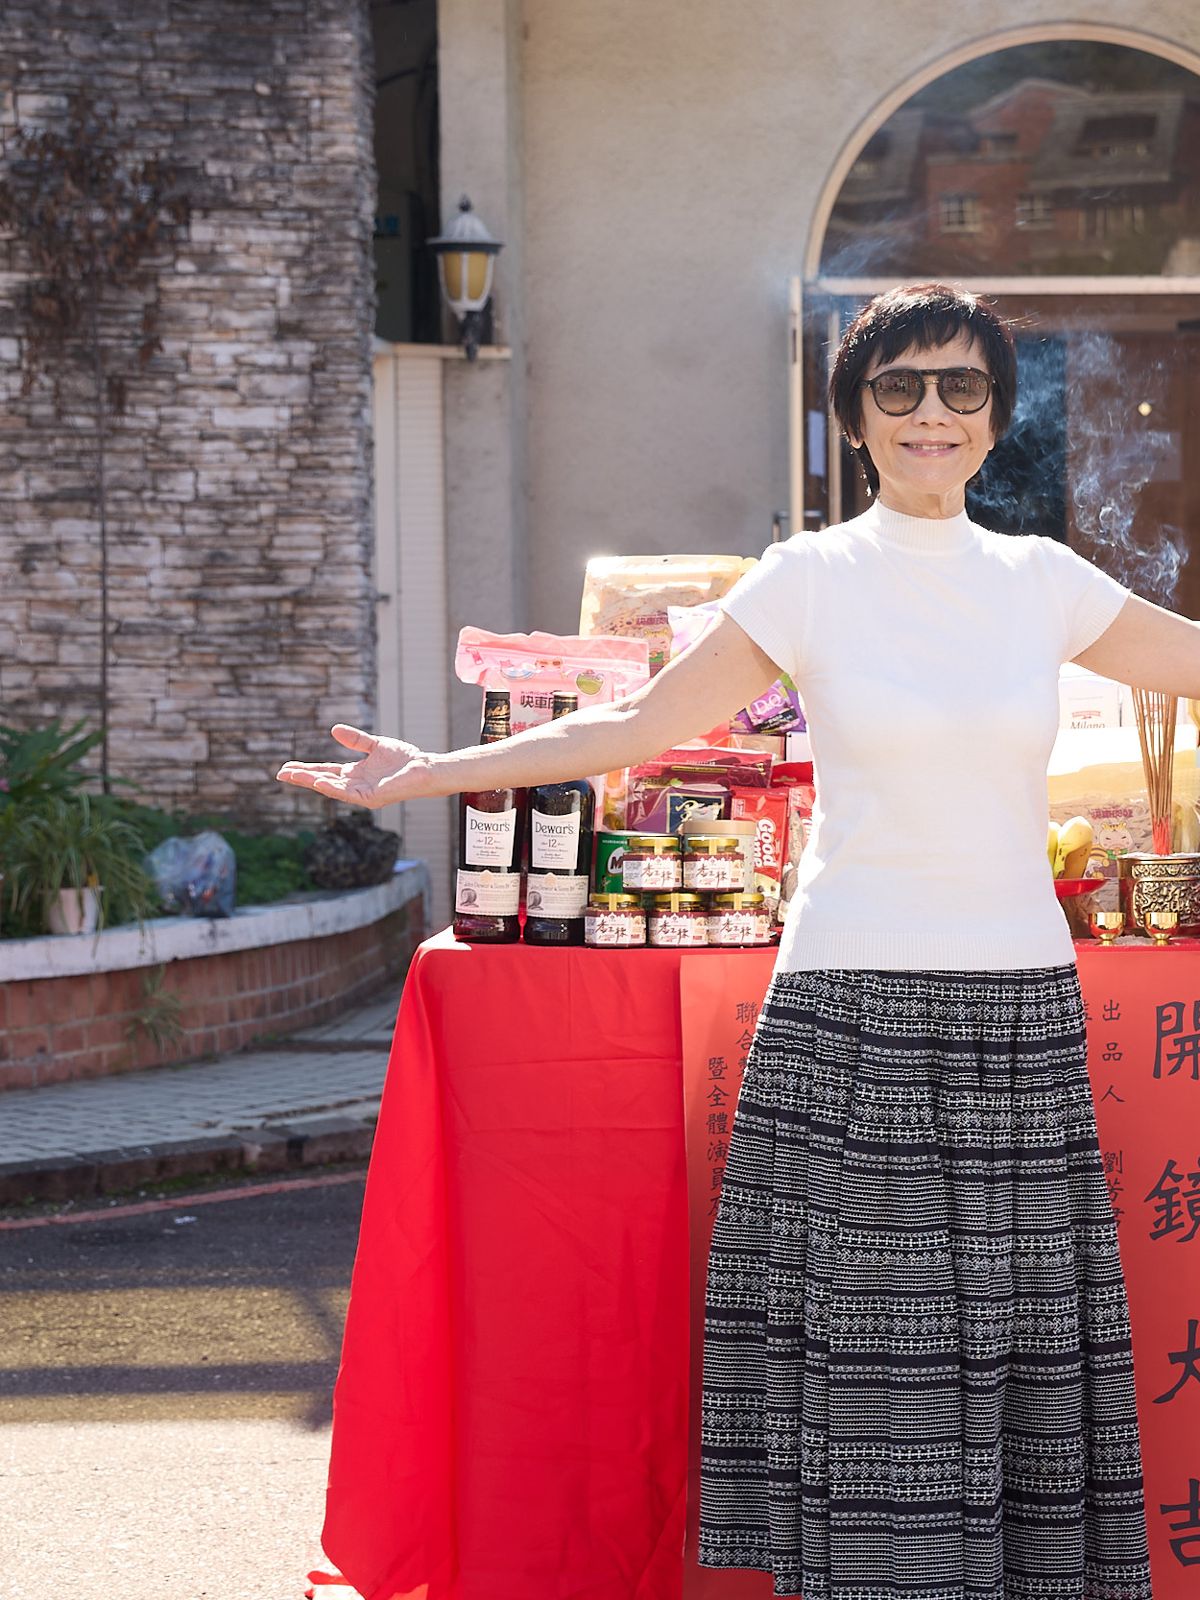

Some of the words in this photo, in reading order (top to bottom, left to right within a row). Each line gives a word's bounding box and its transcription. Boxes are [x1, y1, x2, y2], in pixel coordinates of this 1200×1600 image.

[470, 819, 511, 832] Dewar's
[535, 821, 575, 834] Dewar's
[484, 836, 494, 846] 12
[548, 838, 557, 848] 12
[758, 818, 777, 866] Good
[1101, 999, 1125, 1103] 出品人
